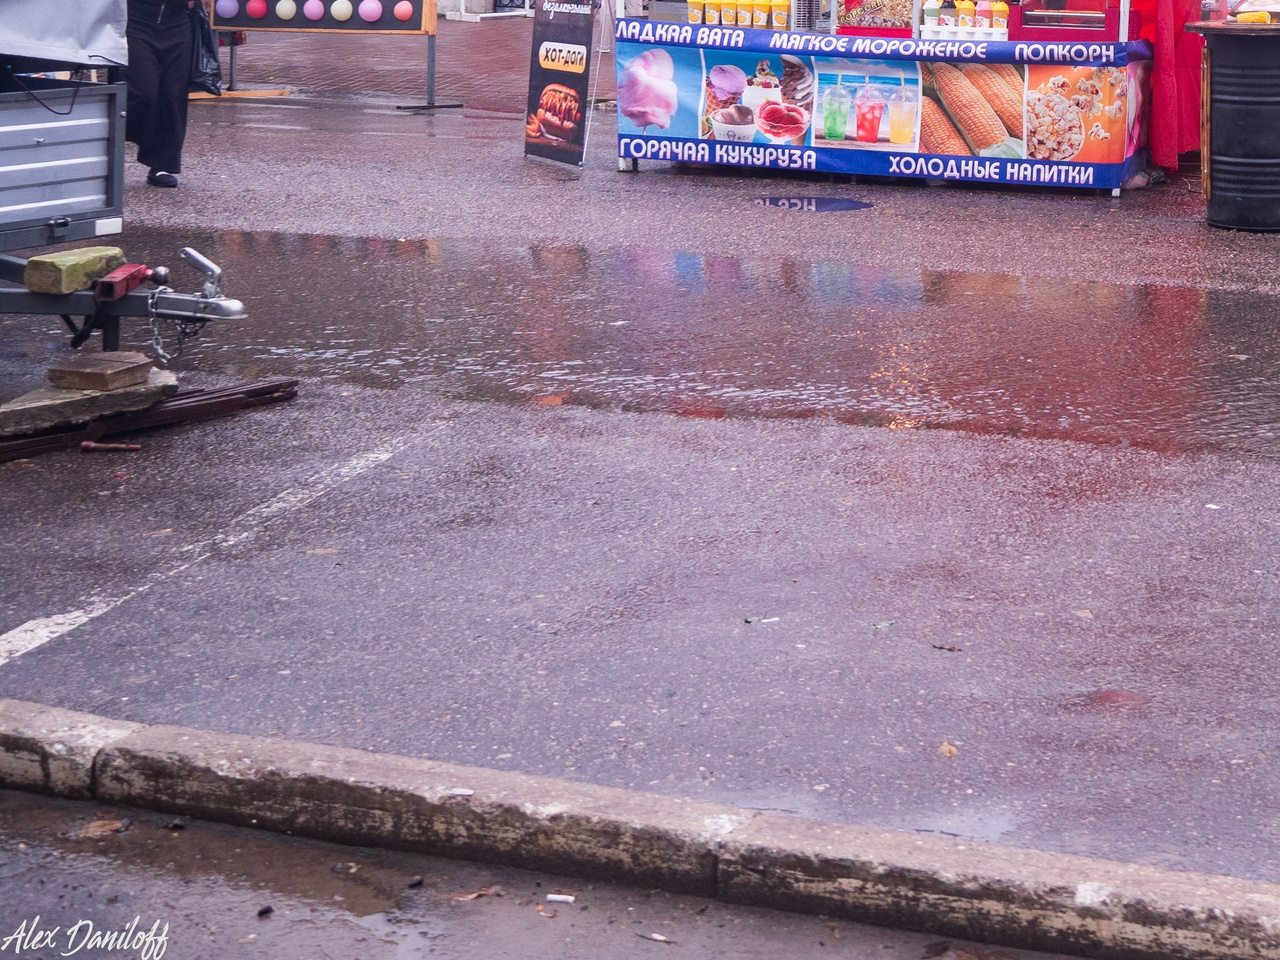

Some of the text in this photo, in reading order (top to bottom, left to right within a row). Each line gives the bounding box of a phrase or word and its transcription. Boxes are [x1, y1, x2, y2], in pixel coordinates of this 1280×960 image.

[543, 47, 584, 67] ХОТ-ДОГИ
[615, 20, 1115, 63] ЛАДКАЯ ВАТА МЯГКОЕ МОРОЖЕНОЕ ПОПКОРН
[619, 138, 1094, 185] ГОРЯЧАЯ КУКУРУЗА ХОЛОДНЫЕ НАПИТКИ
